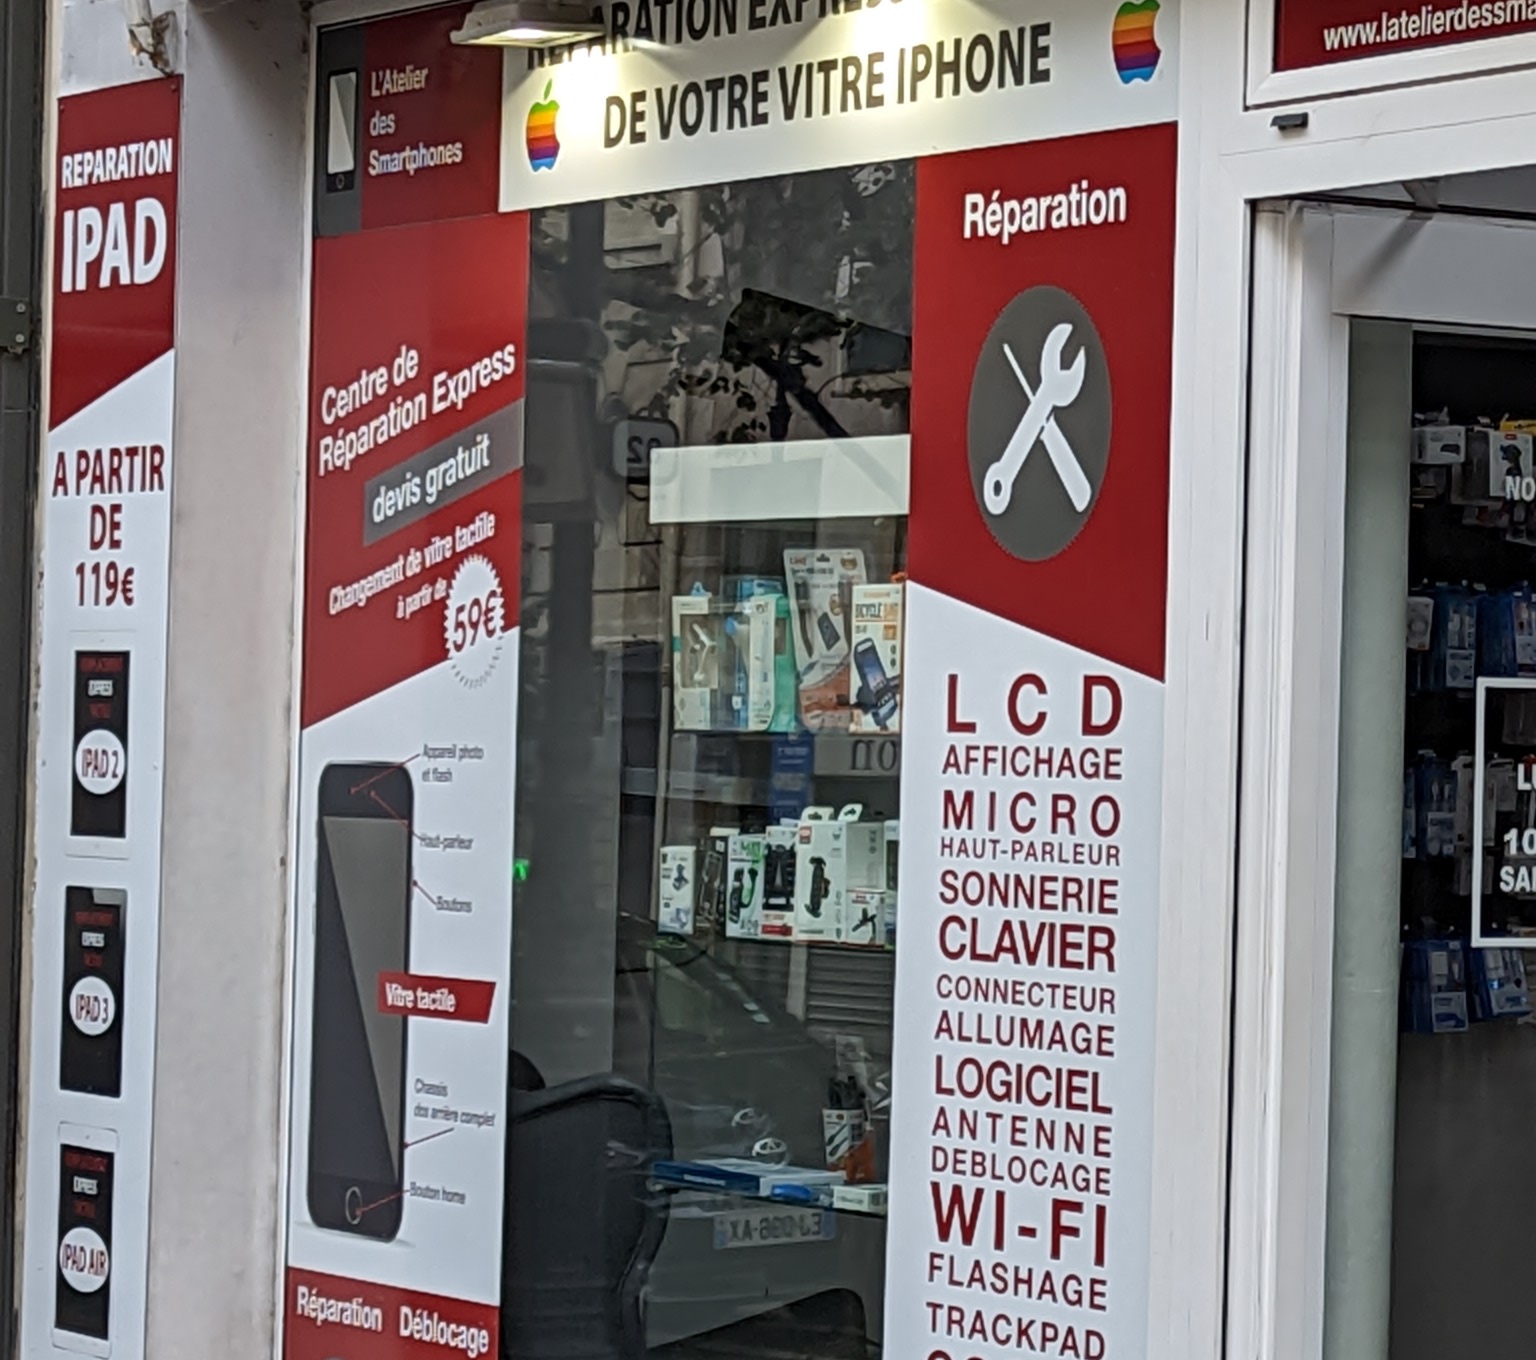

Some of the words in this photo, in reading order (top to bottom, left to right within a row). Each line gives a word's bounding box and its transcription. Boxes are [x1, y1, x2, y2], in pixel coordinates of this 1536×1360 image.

[371, 67, 428, 97] L'Atelier
[604, 92, 646, 148] DE
[655, 71, 769, 140] VOTRE
[780, 51, 884, 120] VITRE
[898, 23, 1050, 104] IPHONE
[370, 111, 395, 135] des
[62, 139, 173, 189] REPARATION
[368, 142, 463, 177] Smartphones
[964, 179, 1126, 244] Réparation
[61, 198, 167, 292] IPAD
[319, 392, 427, 476] Réparation
[432, 343, 516, 415] Express
[321, 368, 388, 425] Centre
[392, 345, 419, 387] de
[53, 451, 68, 496] A
[75, 445, 164, 493] PARTIR
[373, 471, 421, 523] devis
[425, 433, 490, 504] gratuit
[89, 504, 121, 550] DE
[405, 547, 422, 577] de
[424, 535, 453, 569] vitre
[455, 512, 496, 553] tactile
[75, 561, 135, 607] 119€
[453, 590, 500, 653] 59€
[947, 673, 1122, 736] LCD
[82, 748, 109, 778] IPAD
[112, 750, 119, 779] 2
[459, 746, 484, 761] photo
[942, 744, 1122, 780] AFFICHAGE
[943, 790, 1121, 837] MICRO
[940, 837, 1120, 867] HAUT-PARLEUR
[939, 870, 1119, 914] SONNERIE
[939, 915, 1116, 972] CLAVIER
[75, 993, 99, 1023] IPAD
[102, 997, 109, 1023] 3
[385, 982, 414, 1008] Vitre
[417, 987, 455, 1012] tactile
[936, 974, 1115, 1014] CONNECTEUR
[935, 1010, 1115, 1057] ALLUMAGE
[935, 1055, 1112, 1114] LOGICIEL
[932, 1106, 1112, 1158] ANTENNE
[931, 1146, 1111, 1196] DEBLOCAGE
[931, 1181, 1106, 1267] WI-FI
[62, 1242, 86, 1273] IPAD
[88, 1246, 106, 1277] AIR
[929, 1252, 1107, 1311] FLASHAGE
[297, 1286, 383, 1333] Réparation
[400, 1305, 488, 1358] Déblocage
